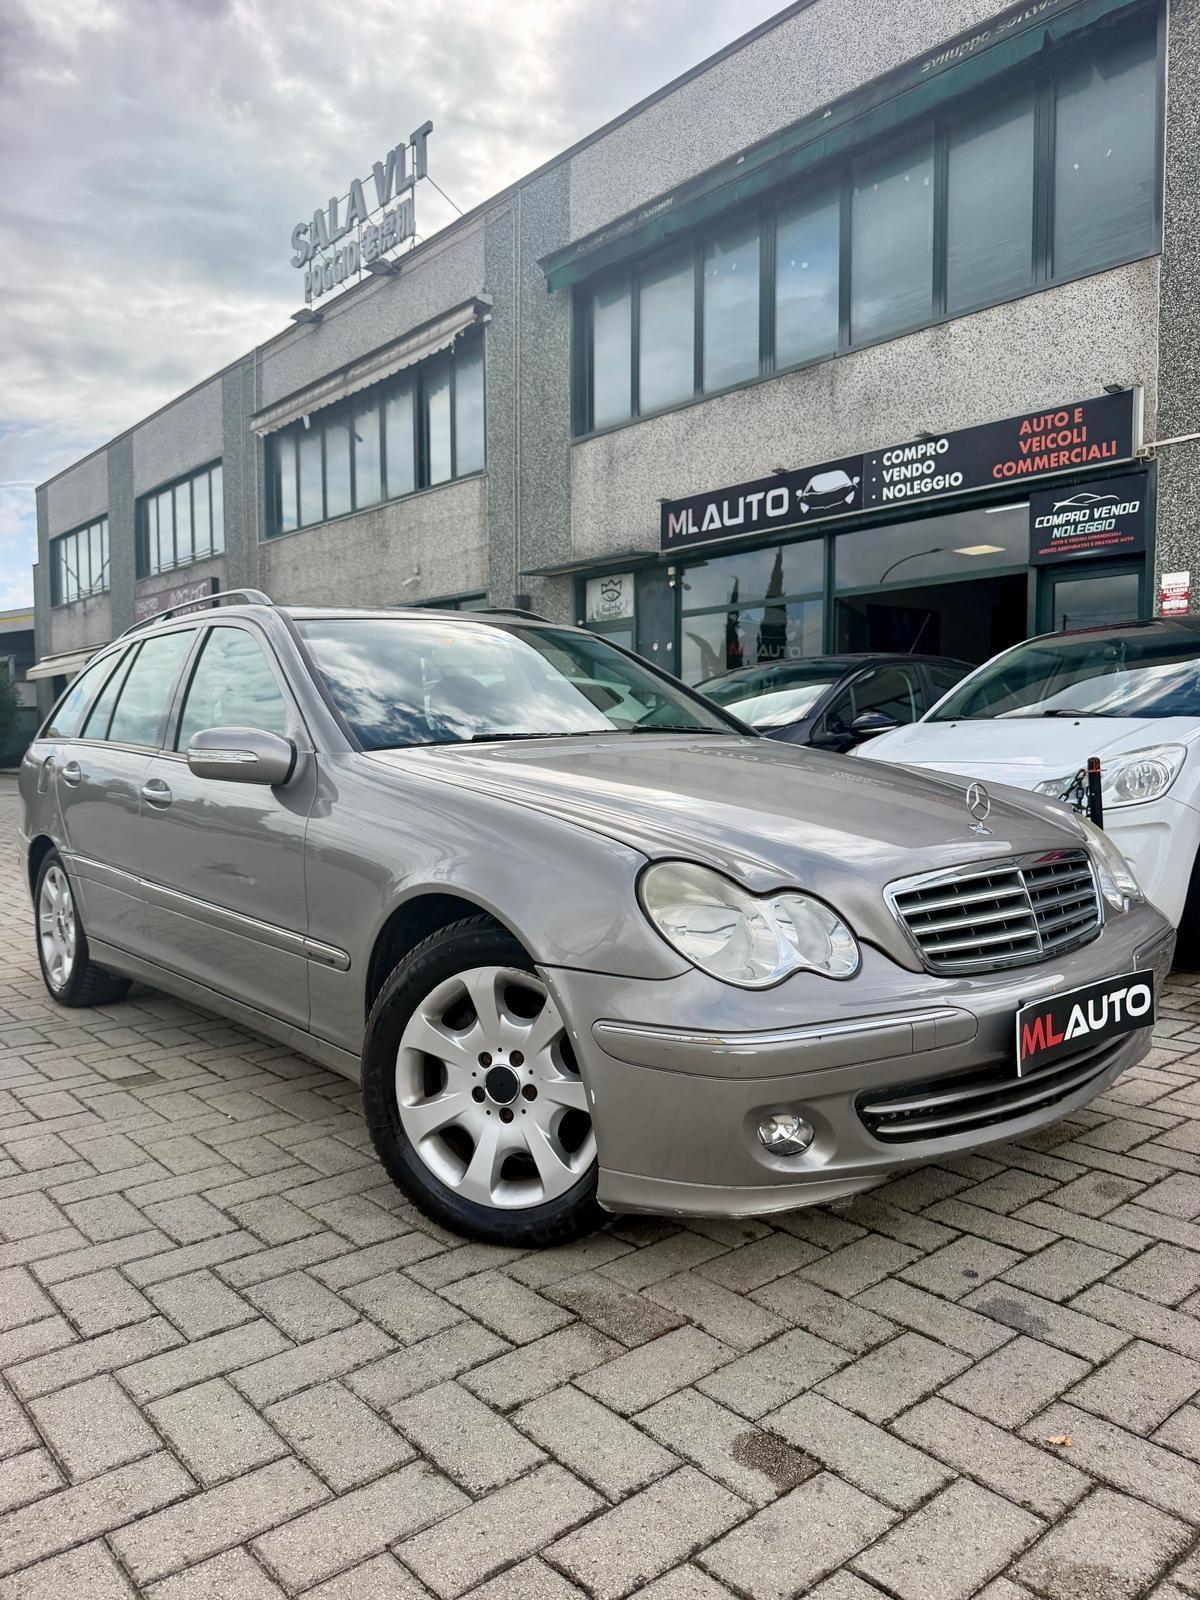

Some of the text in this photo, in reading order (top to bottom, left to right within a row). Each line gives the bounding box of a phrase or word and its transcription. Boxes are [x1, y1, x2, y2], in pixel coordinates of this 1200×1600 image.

[290, 120, 433, 268] SALA VLT
[305, 241, 361, 303] POGGIO
[1019, 407, 1084, 436] AUTO E
[882, 438, 949, 467] COMPRO
[1019, 426, 1087, 455] VEICOLI
[882, 460, 936, 483] VENDO
[992, 440, 1117, 480] COMMERCIALI
[882, 472, 963, 501] NOLEGGIO
[1034, 501, 1140, 528] COMPRO VENDO
[1052, 519, 1116, 539] NOLEGGIO
[1088, 531, 1121, 540] COMMERCIALI
[756, 644, 801, 657] AUTO
